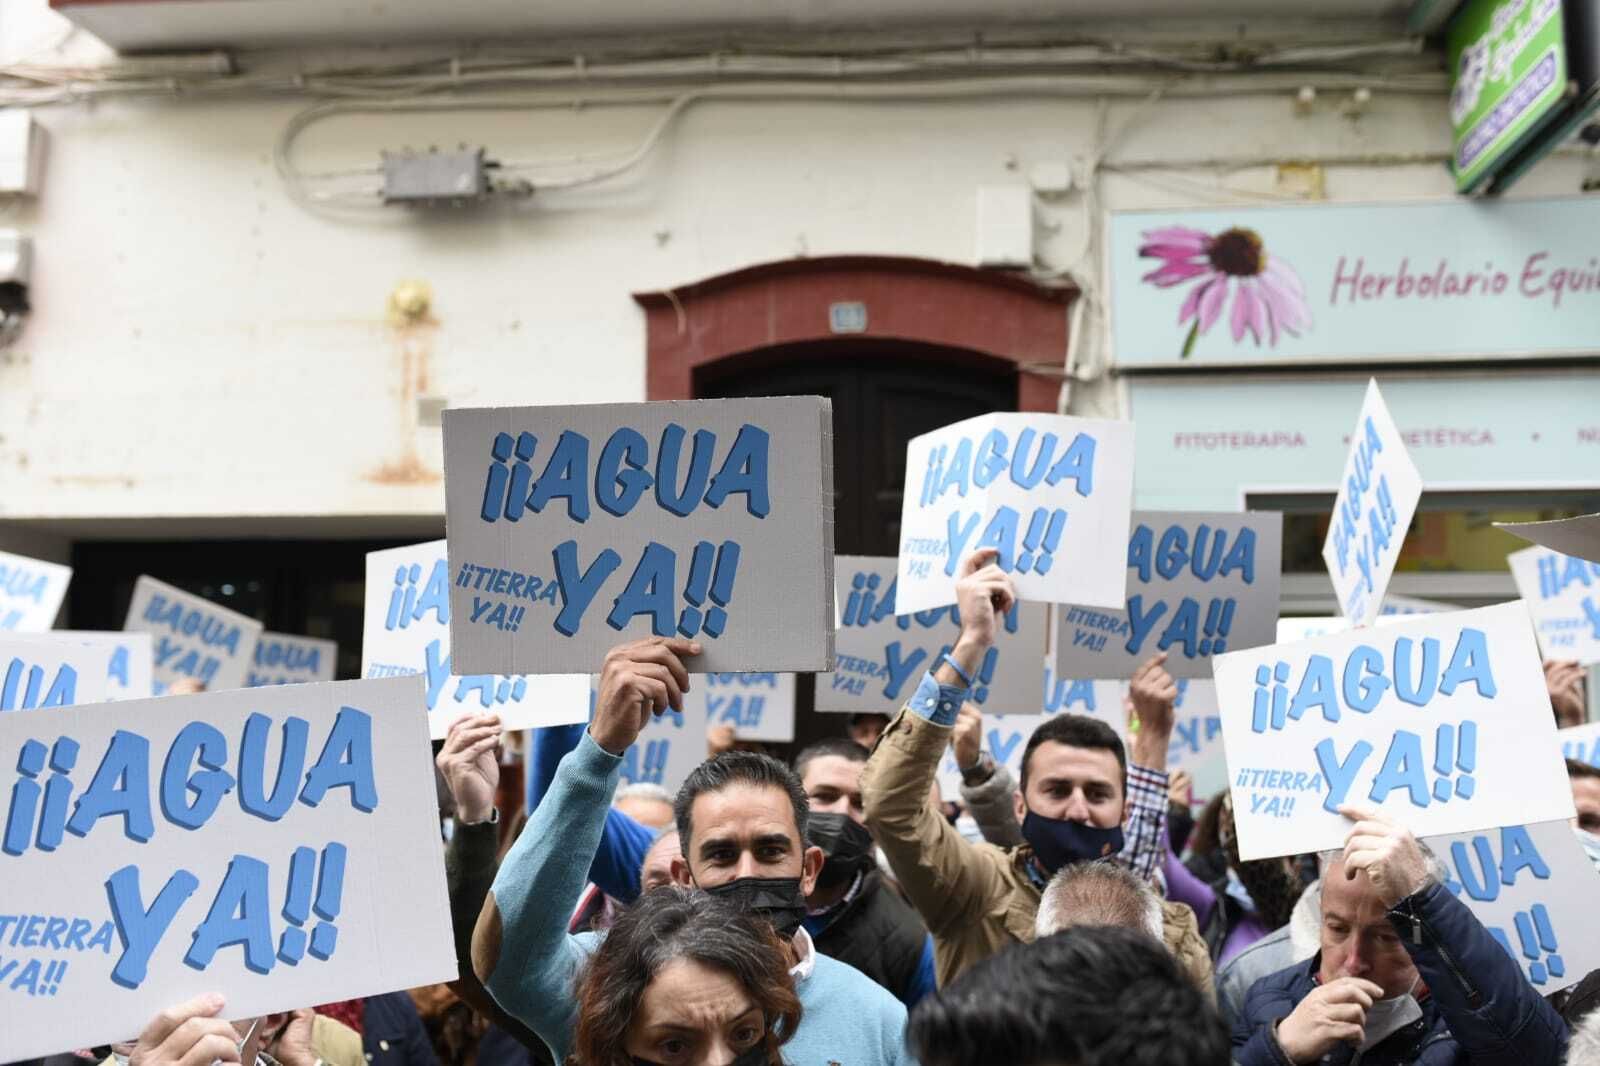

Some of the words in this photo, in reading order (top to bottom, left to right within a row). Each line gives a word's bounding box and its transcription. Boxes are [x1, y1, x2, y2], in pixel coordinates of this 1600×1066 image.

[1330, 255, 1508, 306] Herbolario
[920, 426, 1097, 508] ¡¡AGUA
[1173, 431, 1307, 451] FITOTERAPIA
[480, 423, 770, 523] ¡¡AGUA
[944, 505, 1068, 577] YA!!
[1127, 523, 1257, 585] AGUA
[385, 558, 450, 631] ¡¡A
[456, 563, 560, 606] ¡¡TIERRA
[470, 597, 525, 633] YA!!
[552, 540, 741, 639] YA!!
[1065, 607, 1129, 637] ¡¡TIERRA
[1072, 629, 1107, 652] YA!!
[1125, 594, 1236, 659] YA!!
[836, 655, 888, 680] TIERRA
[1252, 627, 1497, 734] ¡¡AGUA
[2, 706, 378, 856] ¡¡AGUA
[1236, 767, 1322, 793] ¡¡TIERRA
[1314, 719, 1477, 814] YA!!
[1249, 793, 1295, 818] YA!!
[104, 842, 347, 990] YA!!
